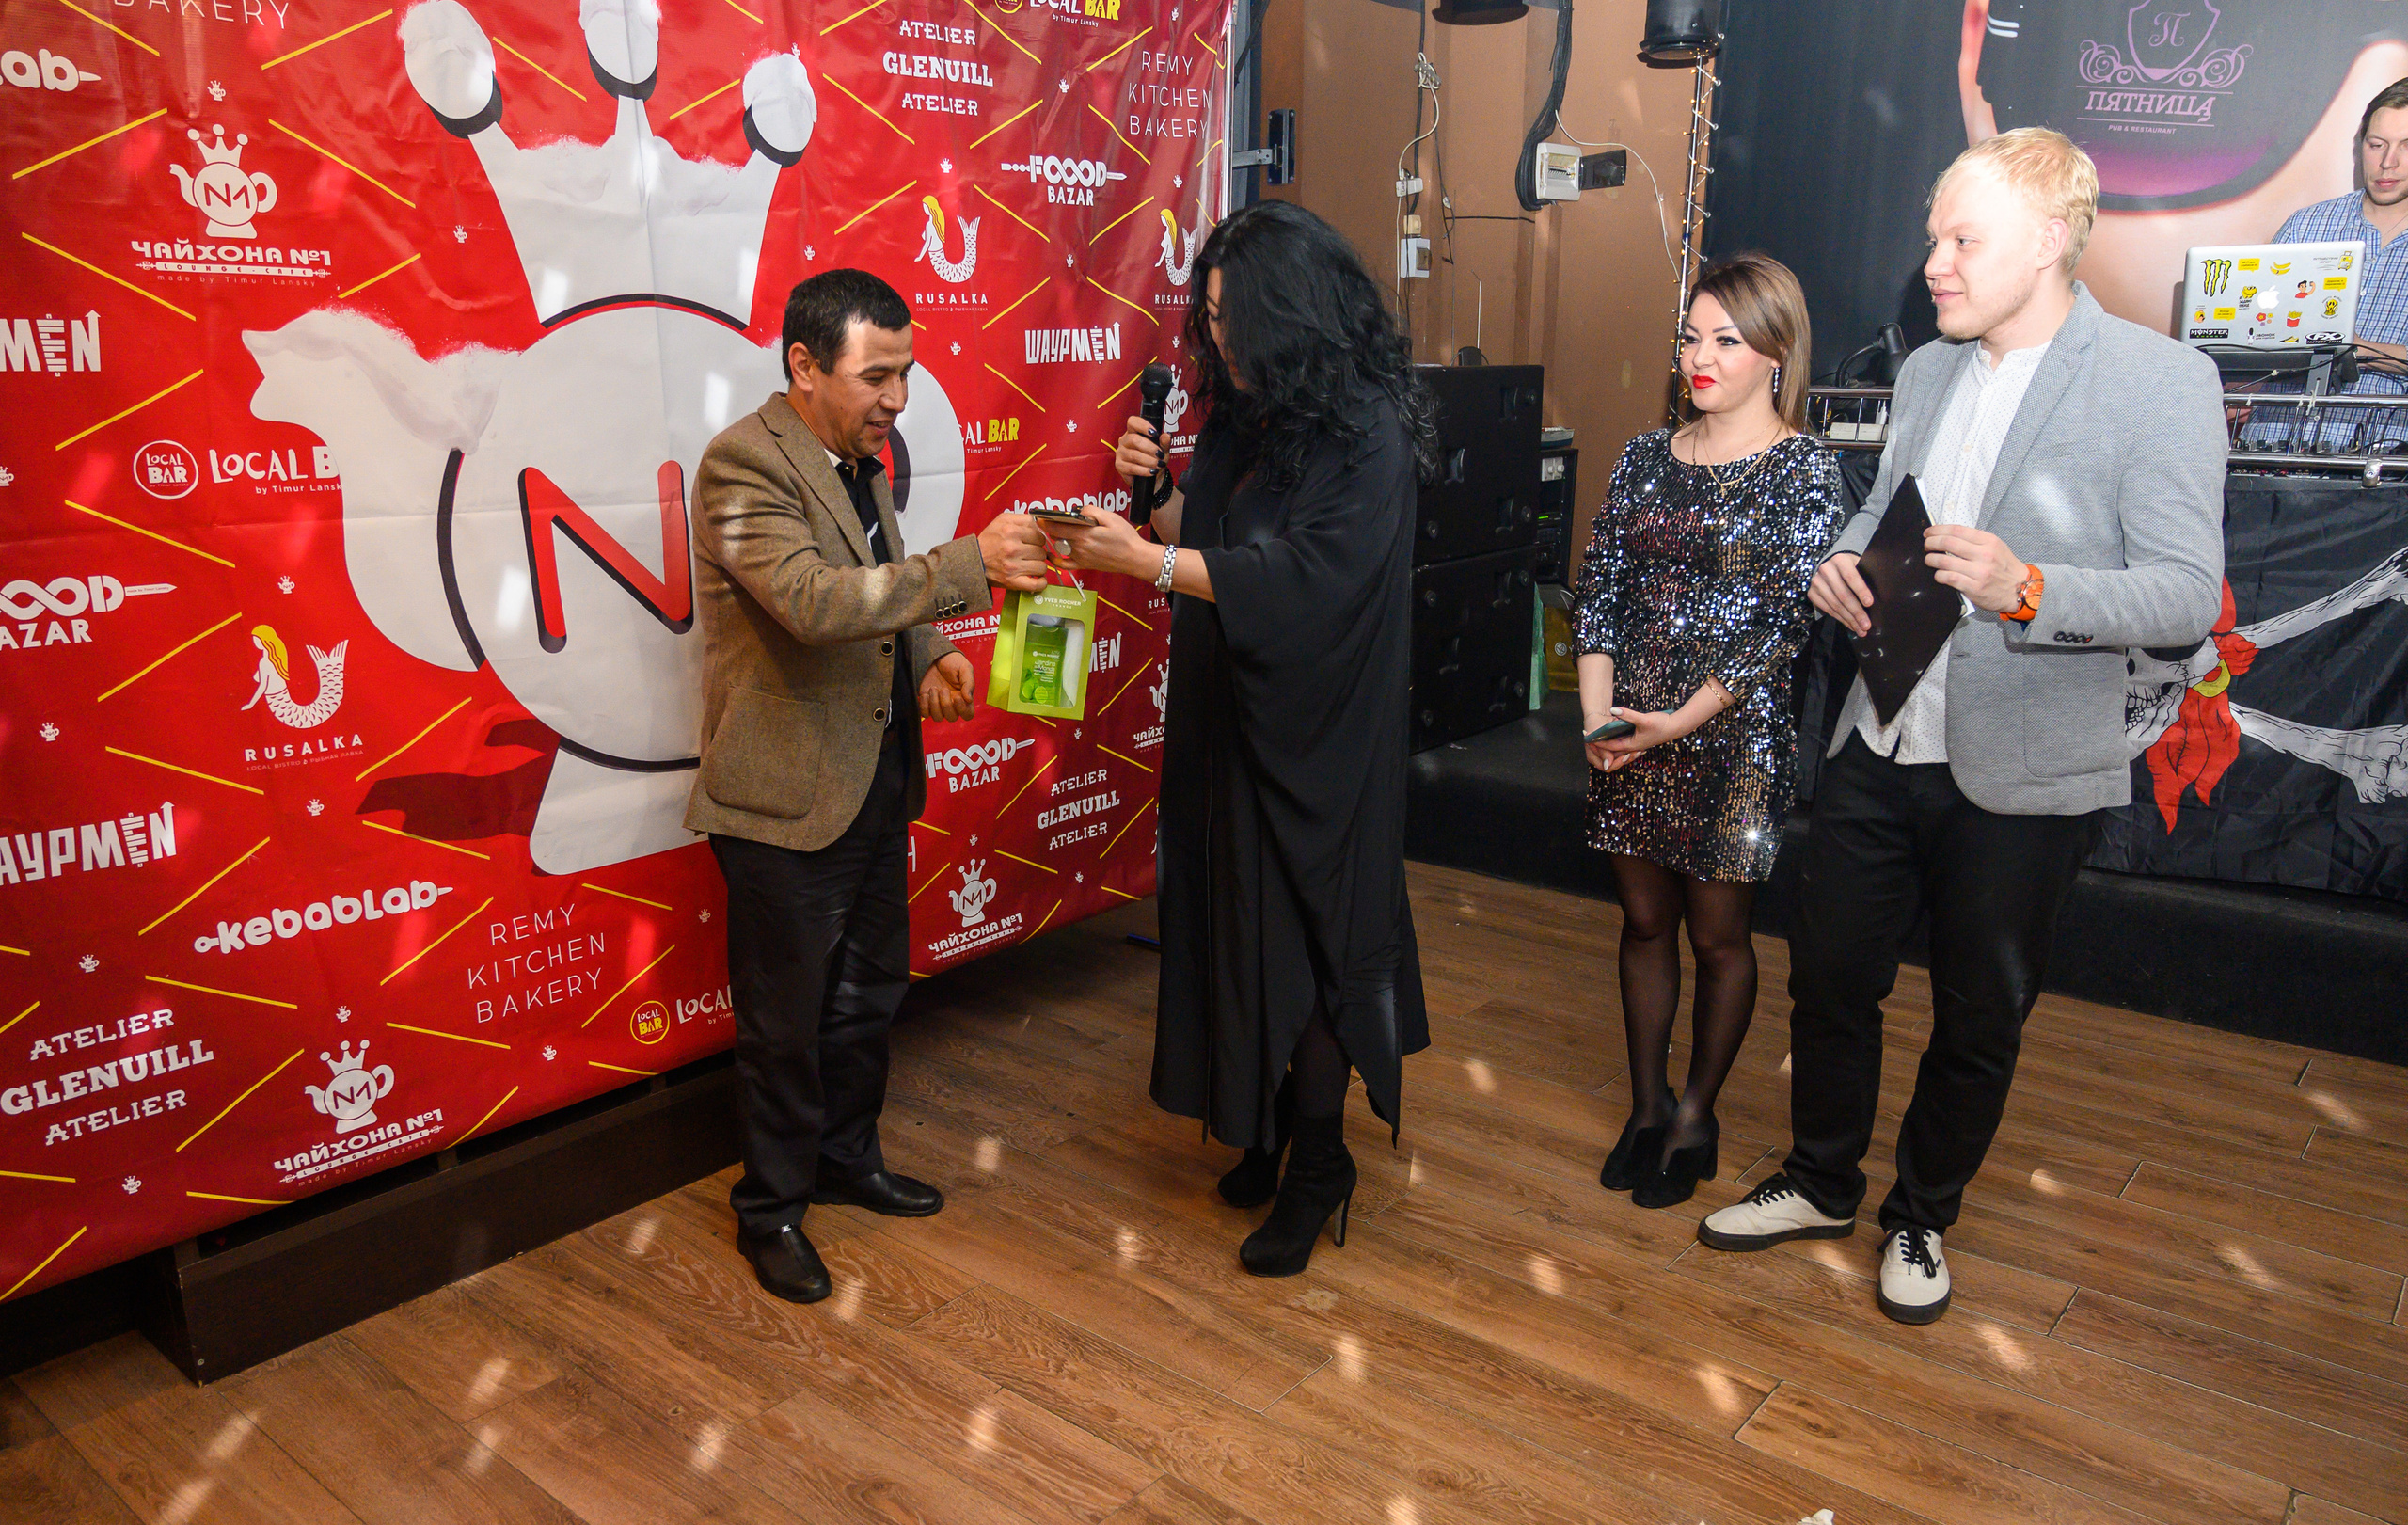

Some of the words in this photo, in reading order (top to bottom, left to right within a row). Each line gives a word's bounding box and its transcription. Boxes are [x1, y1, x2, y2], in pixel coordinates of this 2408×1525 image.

[115, 0, 289, 30] KERY
[1060, 15, 1079, 24] Timur
[1080, 18, 1099, 27] Lansky
[899, 20, 976, 46] ATELIER
[882, 51, 993, 87] GLENUILL
[1141, 50, 1194, 76] REMY
[901, 92, 978, 116] ATELIER
[1128, 82, 1211, 109] KITCHEN
[2084, 90, 2216, 123] ПЯТНИЦА
[1130, 115, 1208, 139] BAKERY
[2131, 126, 2177, 135] RESTAURANT
[1047, 185, 1094, 206] BAZAR
[131, 237, 283, 264] ЧАЙХОНА
[199, 276, 214, 284] by
[272, 278, 316, 287] Lansky
[915, 293, 988, 304] RUSALKA
[988, 417, 1020, 443] BAR
[146, 453, 184, 466] LOCAL
[209, 448, 309, 484] LOCAL
[147, 466, 188, 484] BAR
[255, 486, 268, 495] by
[272, 485, 305, 493] Timur
[1133, 725, 1165, 742] ЧАЙХ
[245, 734, 363, 762] RUSALKA
[948, 766, 1000, 794] BAZAR
[1051, 769, 1107, 796] ATELIER
[1037, 790, 1120, 830] GLENUILL
[1049, 821, 1108, 850] ATELIER
[490, 903, 575, 945] REMY
[928, 921, 999, 952] ЧАЙХОНА
[467, 932, 605, 989] KITCHEN
[477, 967, 601, 1024] BAKERY
[637, 1008, 660, 1023] LOCAL
[638, 1017, 663, 1036] BAR
[30, 1009, 175, 1060] ATELIER
[0, 1039, 214, 1115] GLENUILL
[45, 1089, 187, 1146] ATELIER
[274, 1122, 402, 1172] ЧАЙХОНА
